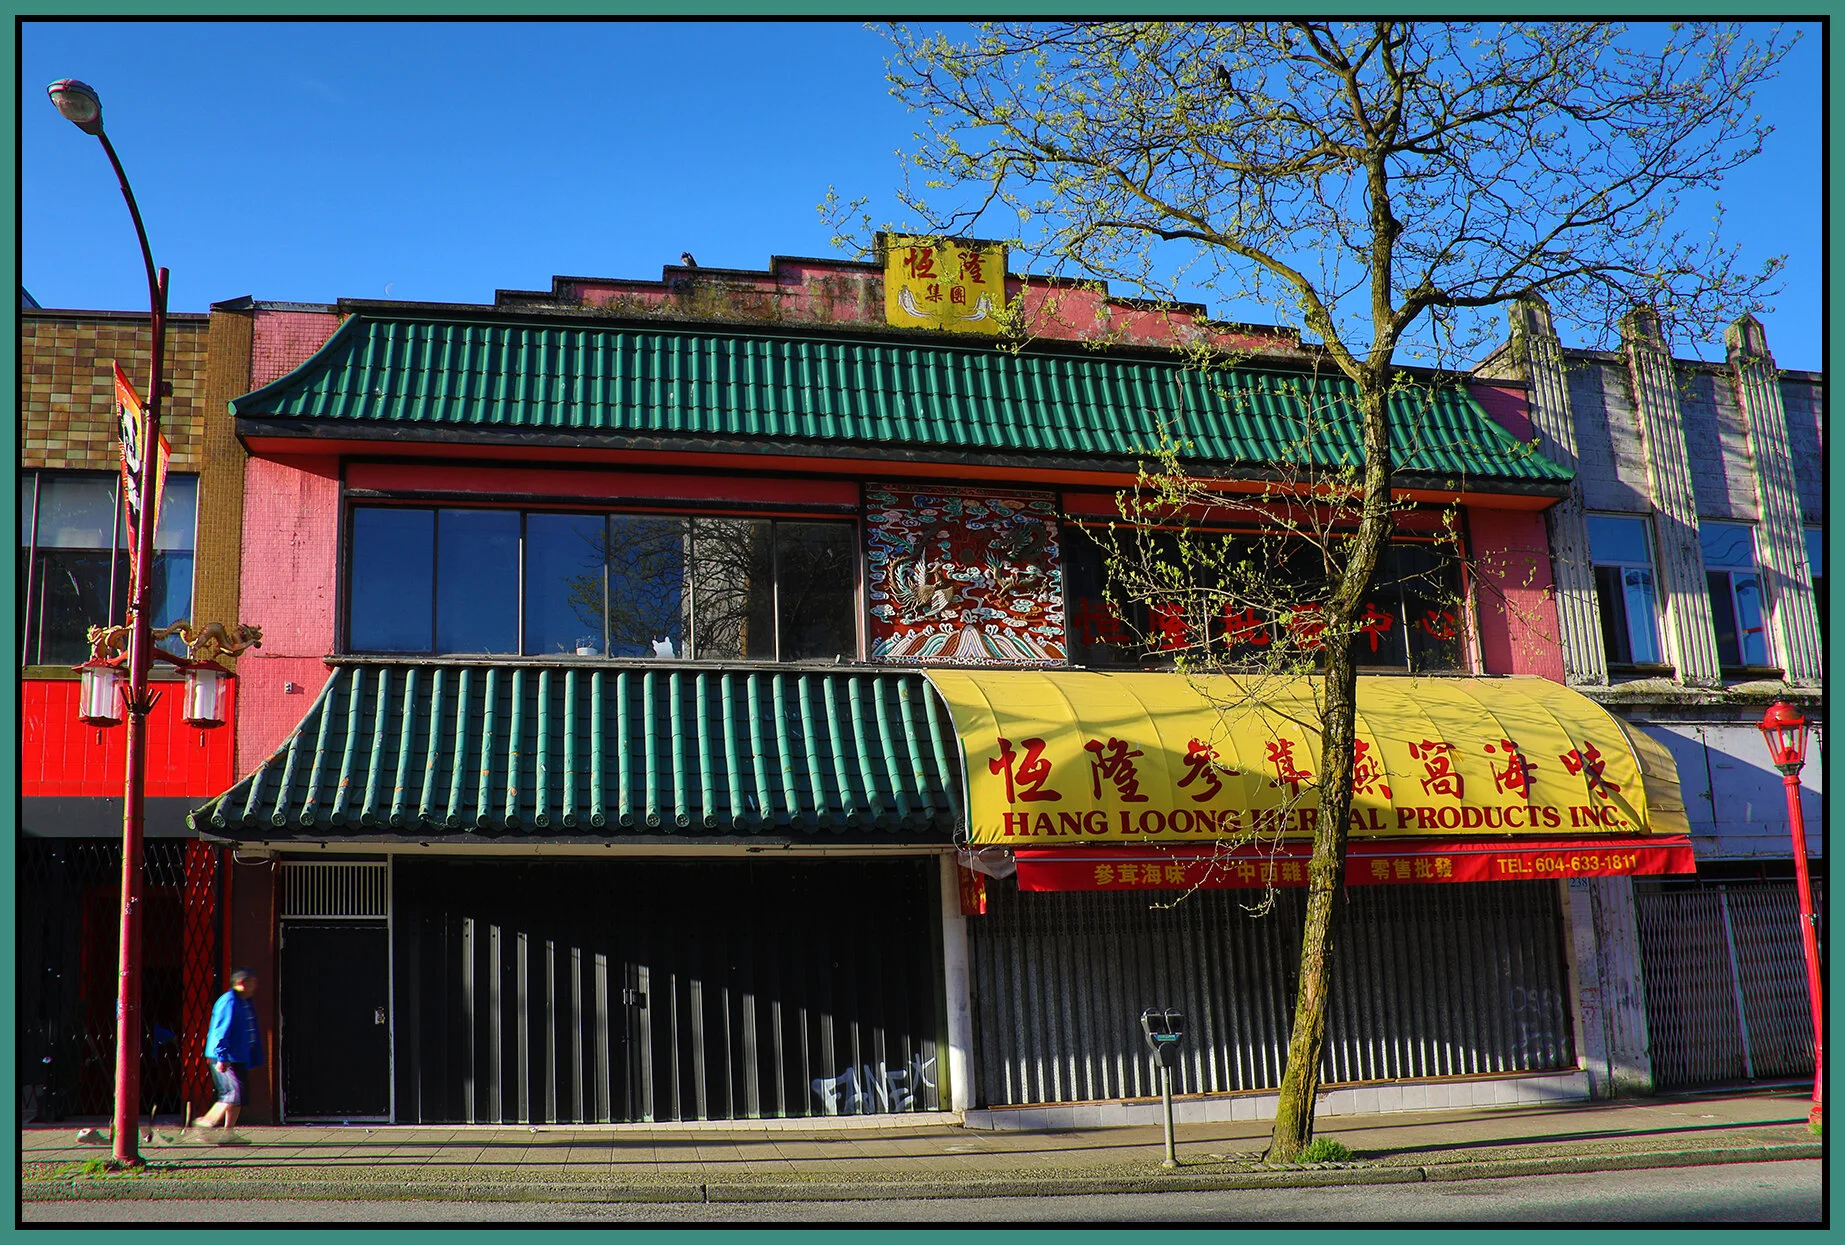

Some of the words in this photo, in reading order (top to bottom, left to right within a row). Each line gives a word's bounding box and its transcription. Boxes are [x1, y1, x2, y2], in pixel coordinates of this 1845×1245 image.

[925, 284, 966, 305] 集團
[1003, 812, 1108, 836] HANG
[1119, 809, 1243, 835] LOONG
[1250, 808, 1387, 833] HERAL
[1396, 806, 1561, 830] PRODUCTS
[1570, 804, 1628, 827] INC.
[1094, 863, 1186, 886] 參茸海味
[1236, 861, 1312, 884] 中西雜
[1370, 857, 1453, 881] 零售批發
[1497, 858, 1533, 874] TEL:
[1535, 854, 1638, 872] 604-633-1811
[1569, 877, 1588, 888] 238
